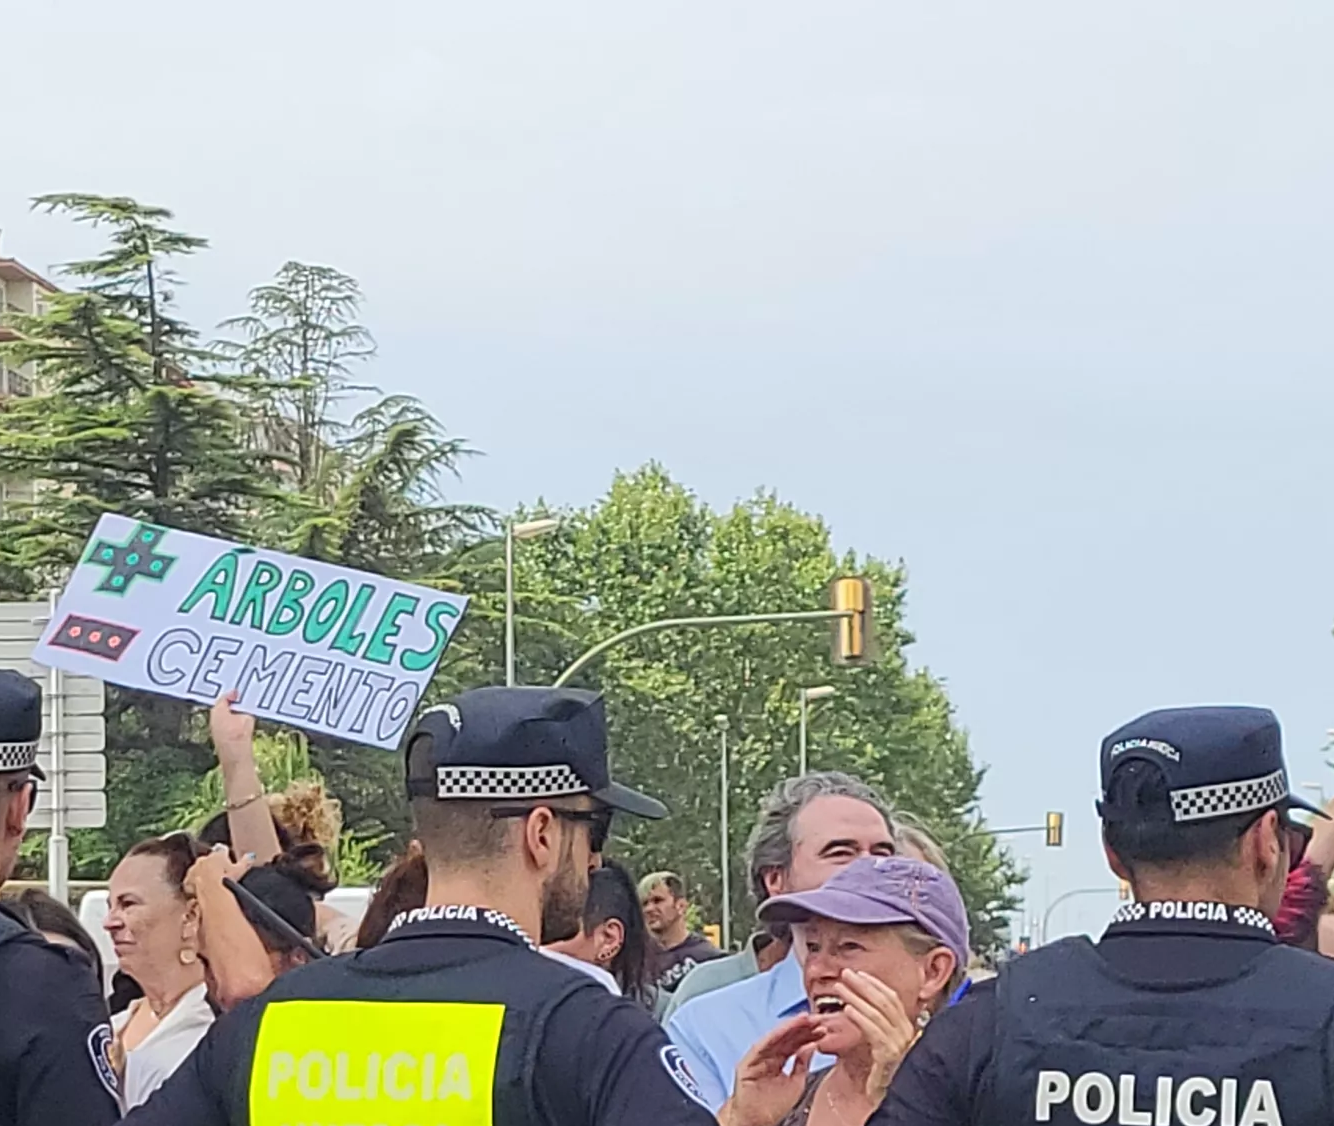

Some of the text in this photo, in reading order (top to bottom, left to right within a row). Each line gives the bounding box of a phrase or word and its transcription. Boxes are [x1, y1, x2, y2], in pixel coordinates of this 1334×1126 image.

[177, 547, 460, 671] ÁRBOLES
[147, 628, 419, 741] CEMENTO
[407, 904, 478, 923] POLICIA
[1149, 902, 1229, 921] POLICIA
[267, 1050, 472, 1101] POLICIA
